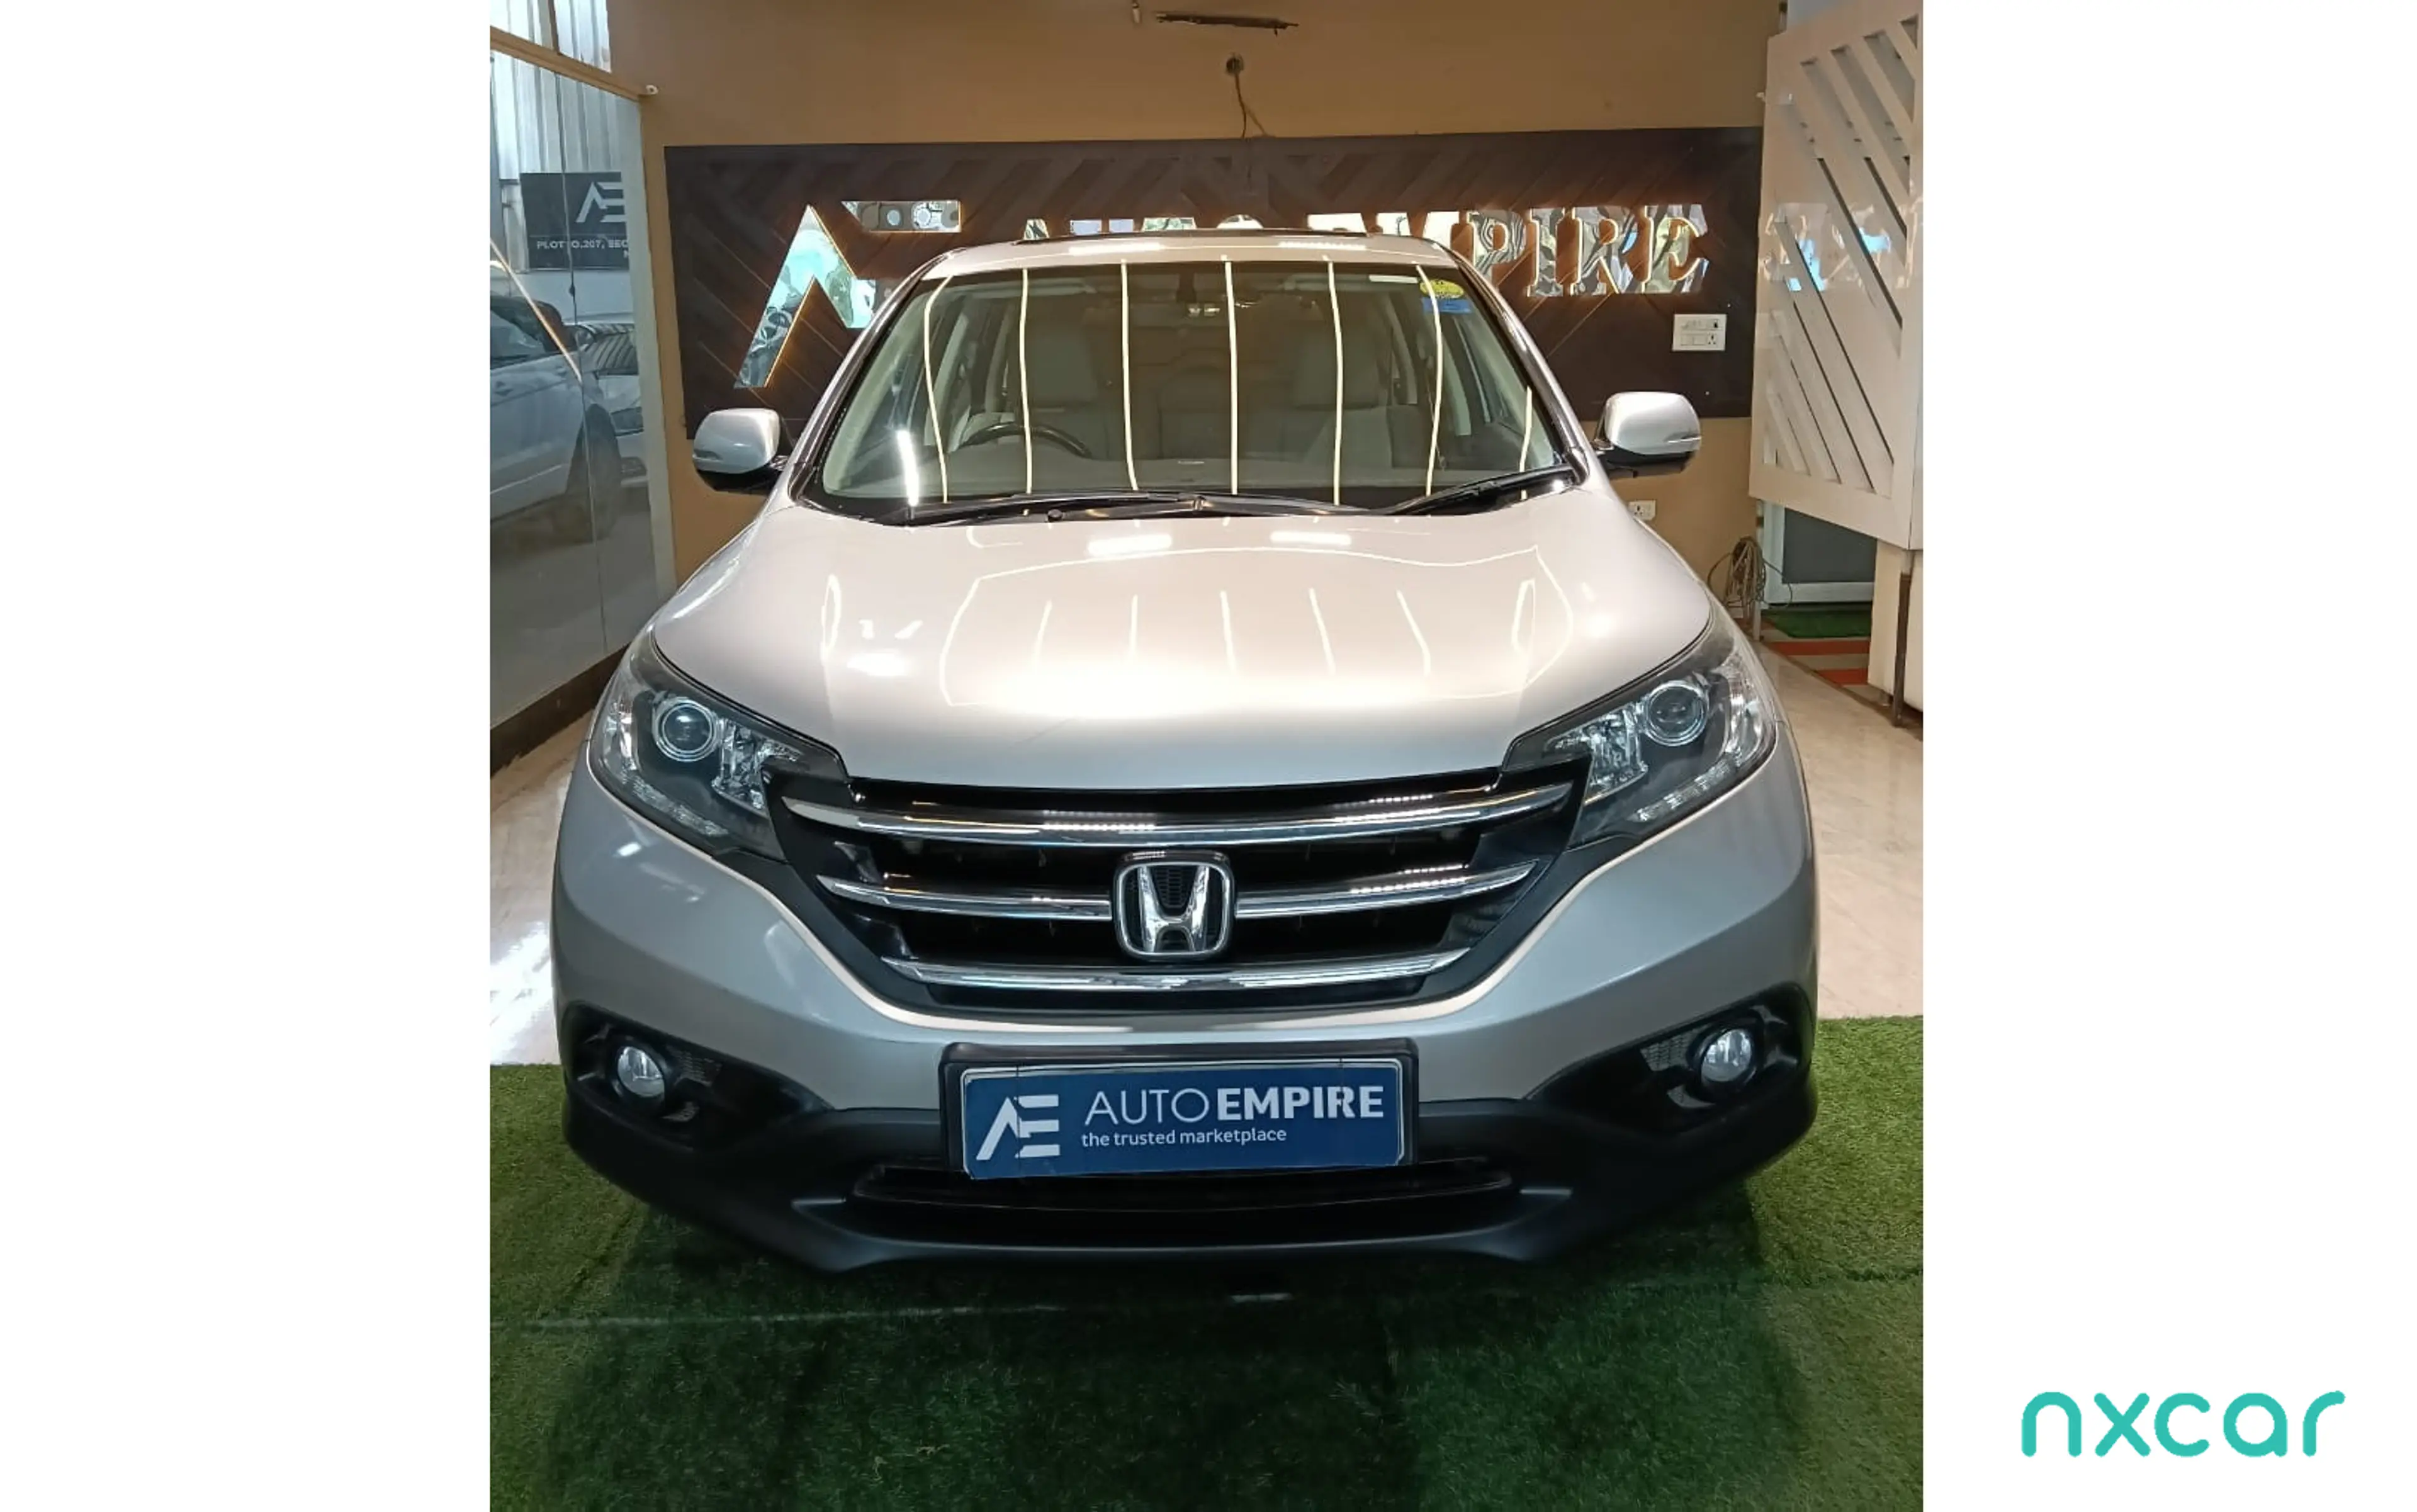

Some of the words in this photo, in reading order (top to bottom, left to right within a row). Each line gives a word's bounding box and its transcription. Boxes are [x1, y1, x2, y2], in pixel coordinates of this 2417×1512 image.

[1085, 1088, 1210, 1126] AUTO
[1217, 1086, 1384, 1121] EMPIRE
[1081, 1132, 1110, 1148] the
[1114, 1130, 1176, 1146] trusted
[1180, 1128, 1287, 1146] marketplace
